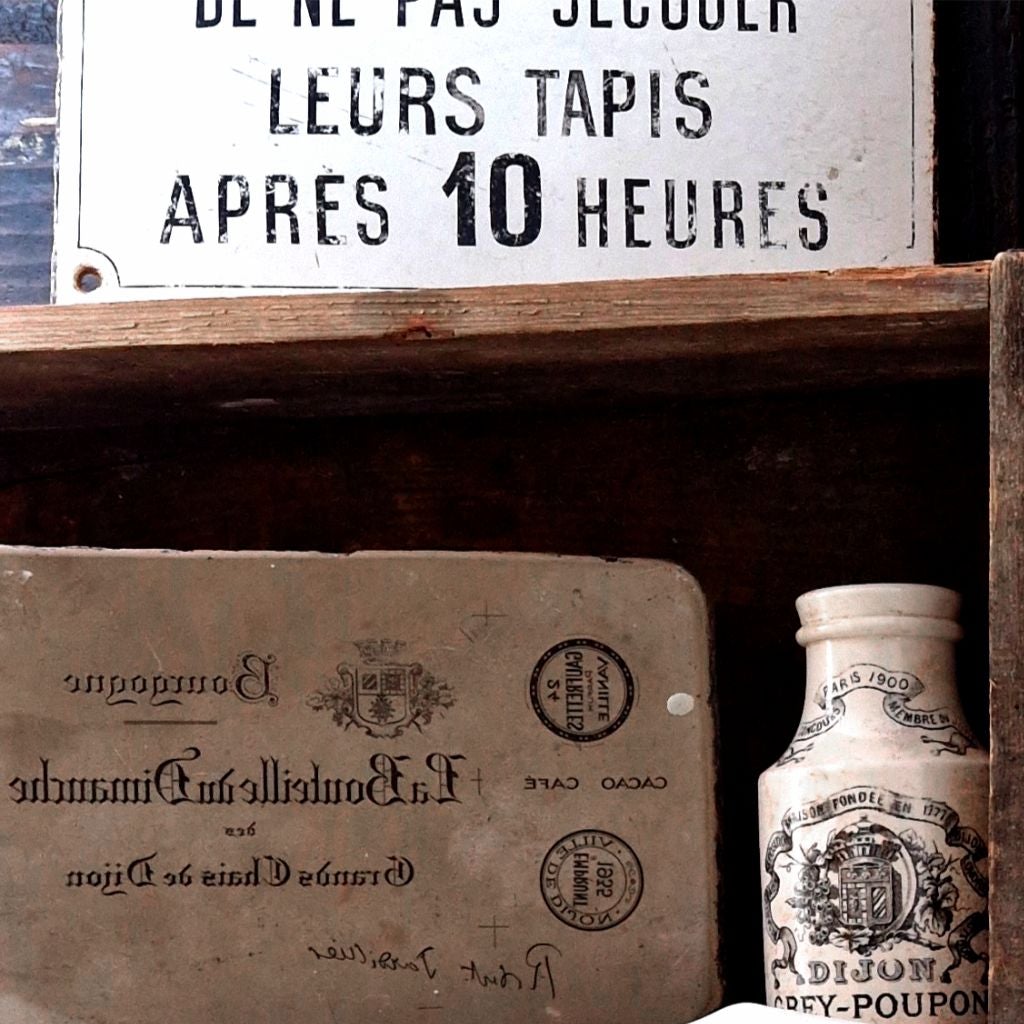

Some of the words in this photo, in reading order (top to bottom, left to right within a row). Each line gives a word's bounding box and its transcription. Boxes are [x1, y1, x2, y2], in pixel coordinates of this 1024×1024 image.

[269, 66, 485, 136] LEURS
[524, 69, 712, 139] TAPIS
[442, 151, 542, 247] 10
[577, 177, 828, 251] HEURES
[822, 671, 861, 698] PARIS
[869, 671, 909, 692] 1900
[808, 957, 936, 985] DIJON
